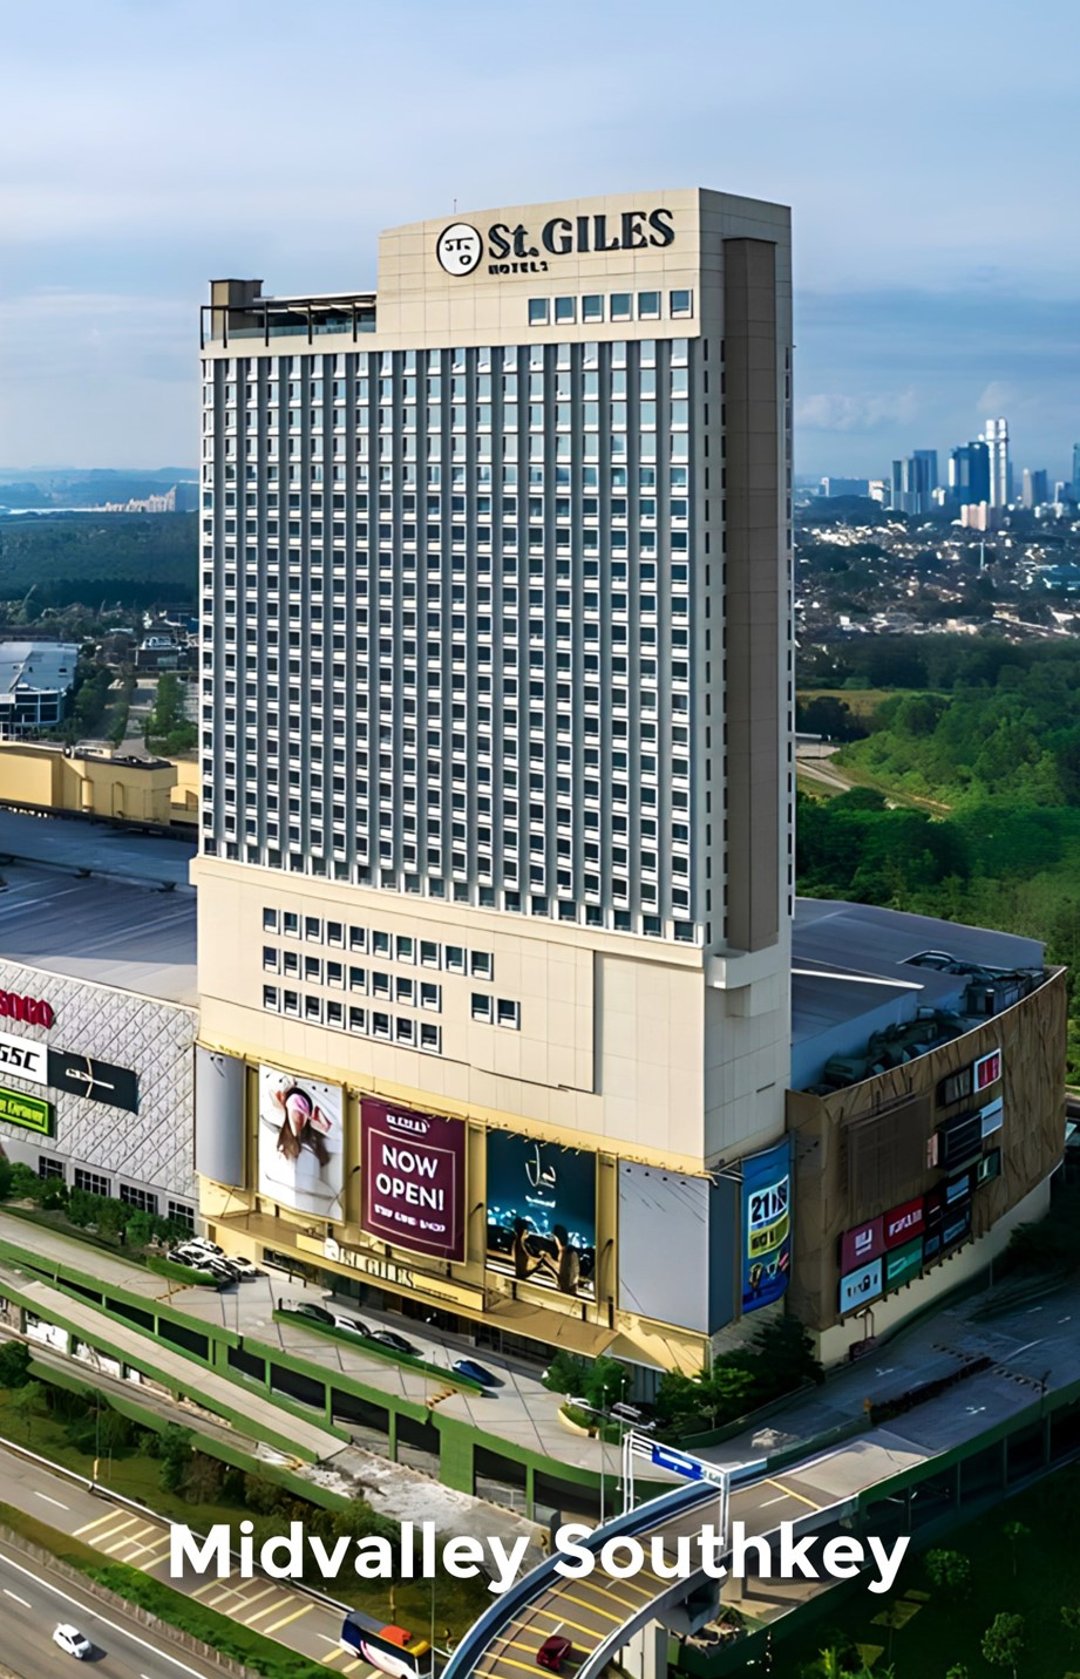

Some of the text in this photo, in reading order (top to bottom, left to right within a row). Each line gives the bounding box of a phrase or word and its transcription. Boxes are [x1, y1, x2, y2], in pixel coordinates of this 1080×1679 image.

[487, 223, 540, 260] St.
[541, 208, 675, 256] GILES
[381, 1143, 439, 1179] NOW
[375, 1172, 445, 1211] OPEN!
